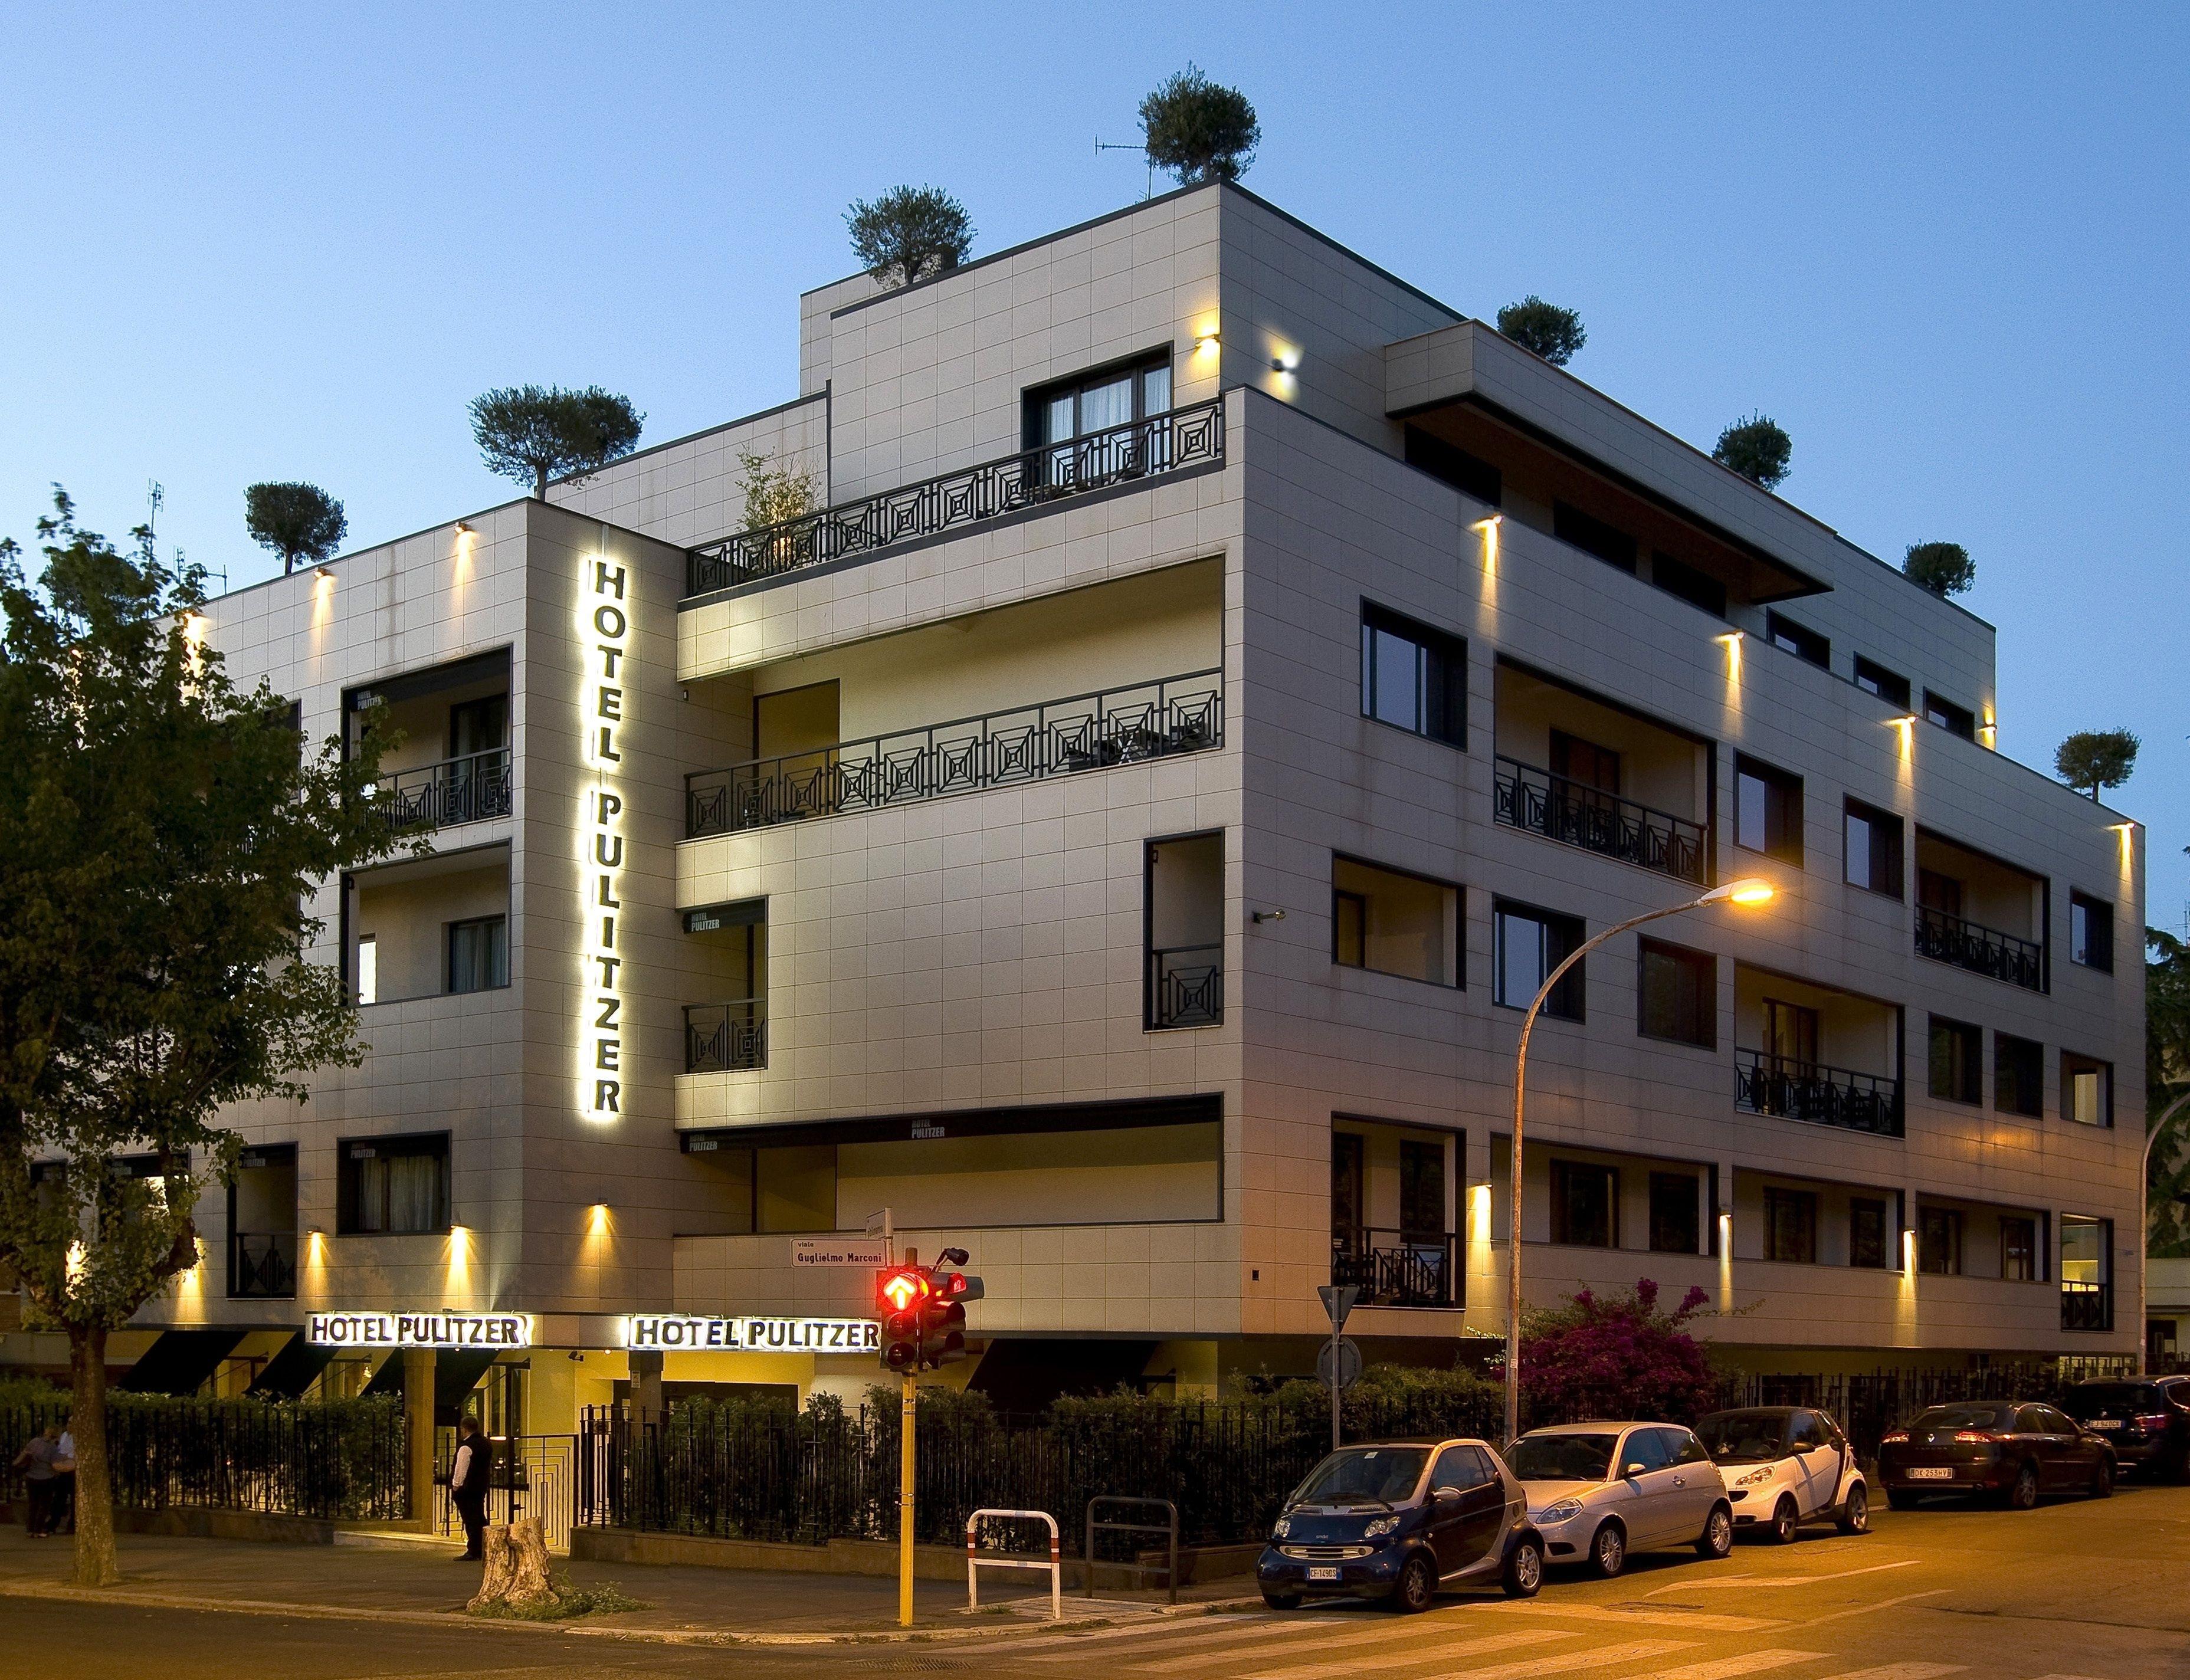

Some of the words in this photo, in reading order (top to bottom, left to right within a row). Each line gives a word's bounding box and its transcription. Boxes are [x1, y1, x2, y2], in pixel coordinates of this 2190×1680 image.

[594, 561, 625, 762] HOTEL
[691, 913, 707, 921] HOTEL
[691, 919, 719, 932] PULITZER
[595, 793, 622, 1113] PULITZER
[912, 1127, 945, 1139] PULITZER
[689, 1141, 717, 1151] PULITZER
[798, 1253, 843, 1264] Guglielmo
[847, 1252, 881, 1262] Marconi
[312, 1317, 392, 1341] HOTEL
[398, 1317, 519, 1344] PULITZER
[635, 1319, 739, 1346] HOTEL
[748, 1321, 878, 1347] PULITZER
